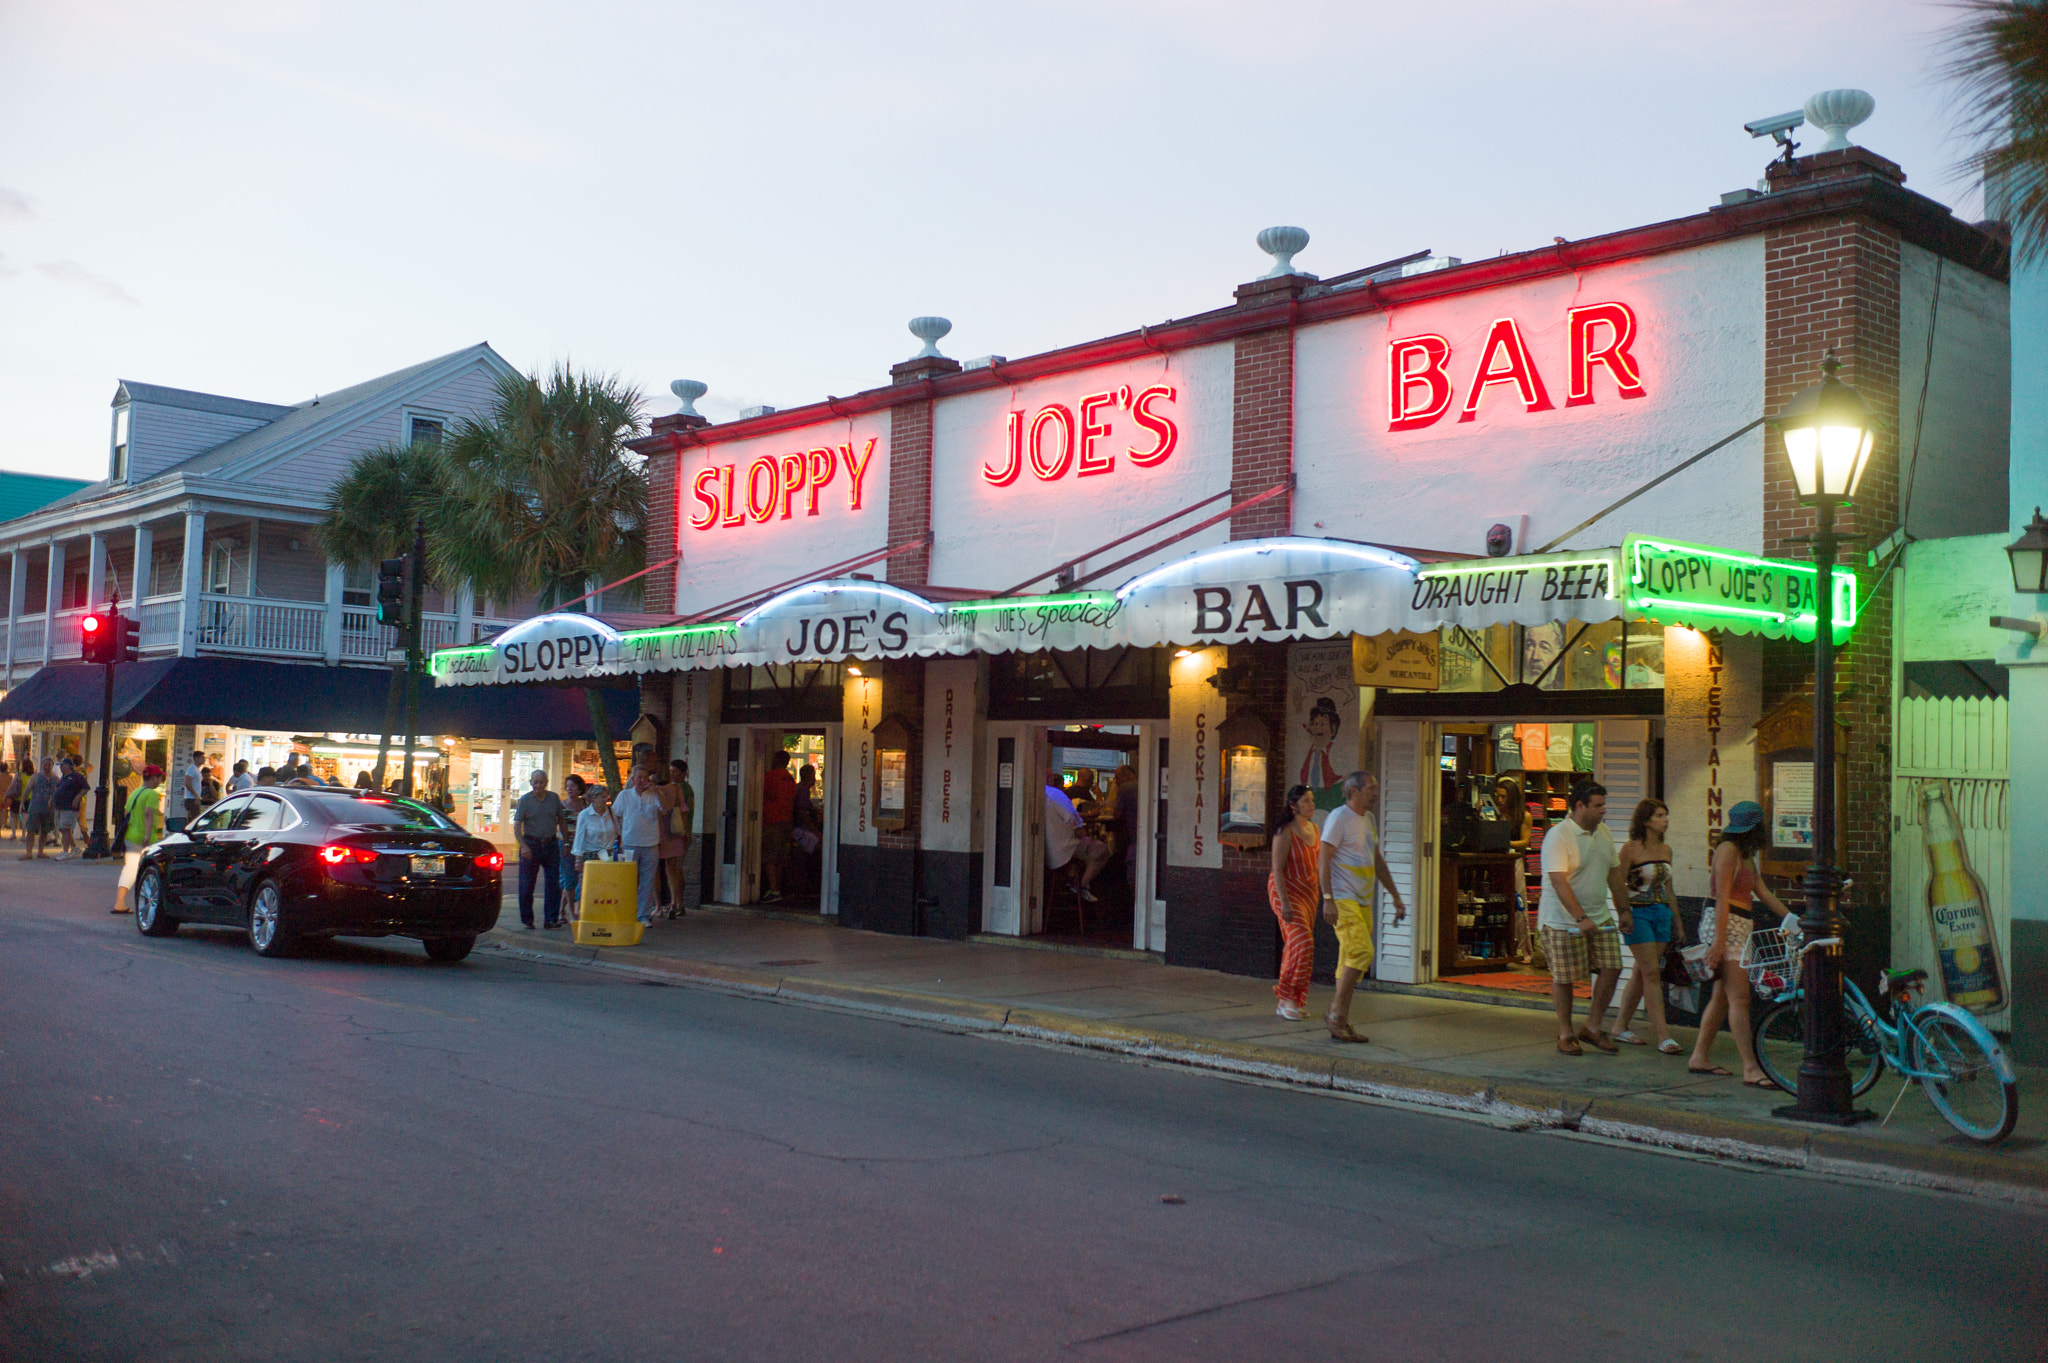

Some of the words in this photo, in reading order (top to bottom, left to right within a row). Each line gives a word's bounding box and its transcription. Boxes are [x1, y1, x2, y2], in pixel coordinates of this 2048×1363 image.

[688, 437, 878, 531] SLOPPY
[981, 384, 1178, 487] JOE'S
[1387, 301, 1646, 432] BAR
[1411, 570, 1529, 611] DRAUGHT
[1541, 563, 1619, 601] BEER
[1631, 554, 1712, 596] SLOPPY
[1720, 565, 1773, 604] JOE'S
[1785, 574, 1817, 610] BA
[937, 610, 978, 636] SLOPPY
[994, 606, 1026, 633] JOE'S
[1028, 596, 1123, 640] Special
[1192, 579, 1329, 635] BAR
[504, 634, 607, 674] SLOPPY
[671, 629, 737, 660] COLADA'S
[786, 609, 909, 655] JOE'S
[1389, 670, 1432, 681] MERCANTILE
[945, 689, 953, 757] DRAFT
[858, 741, 869, 833] COLADAS
[942, 770, 951, 824] BEER
[1193, 713, 1206, 857] COCKTAILS
[1936, 904, 1980, 925] Corona
[1949, 921, 1976, 932] Extra
